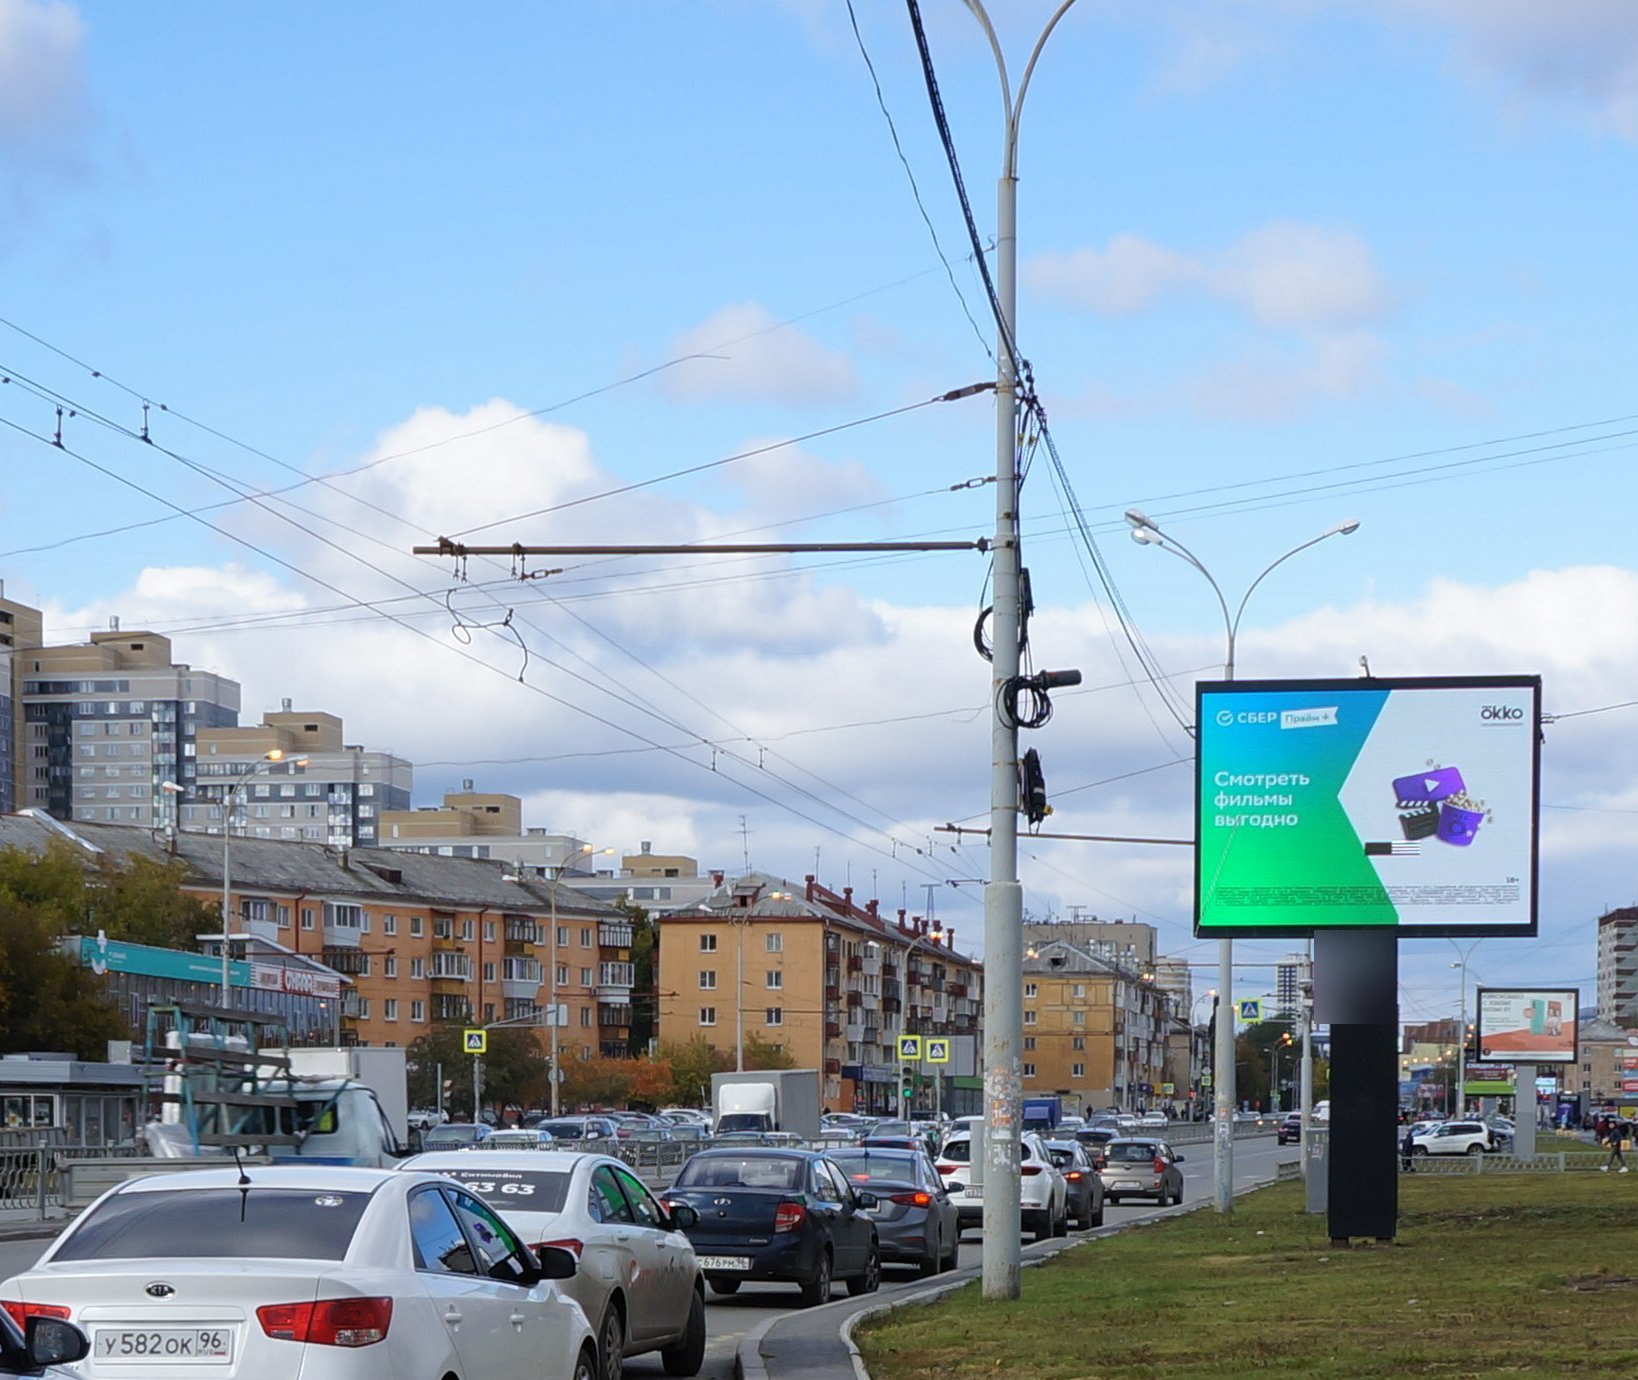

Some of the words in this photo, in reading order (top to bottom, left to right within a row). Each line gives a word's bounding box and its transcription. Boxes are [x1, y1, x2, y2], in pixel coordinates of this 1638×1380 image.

[1237, 711, 1278, 724] СБЕР
[1213, 770, 1311, 790] Смотреть
[1213, 790, 1294, 810] фильмы
[1214, 813, 1299, 829] выгодно
[501, 1182, 536, 1195] 63
[199, 1332, 222, 1348] 96
